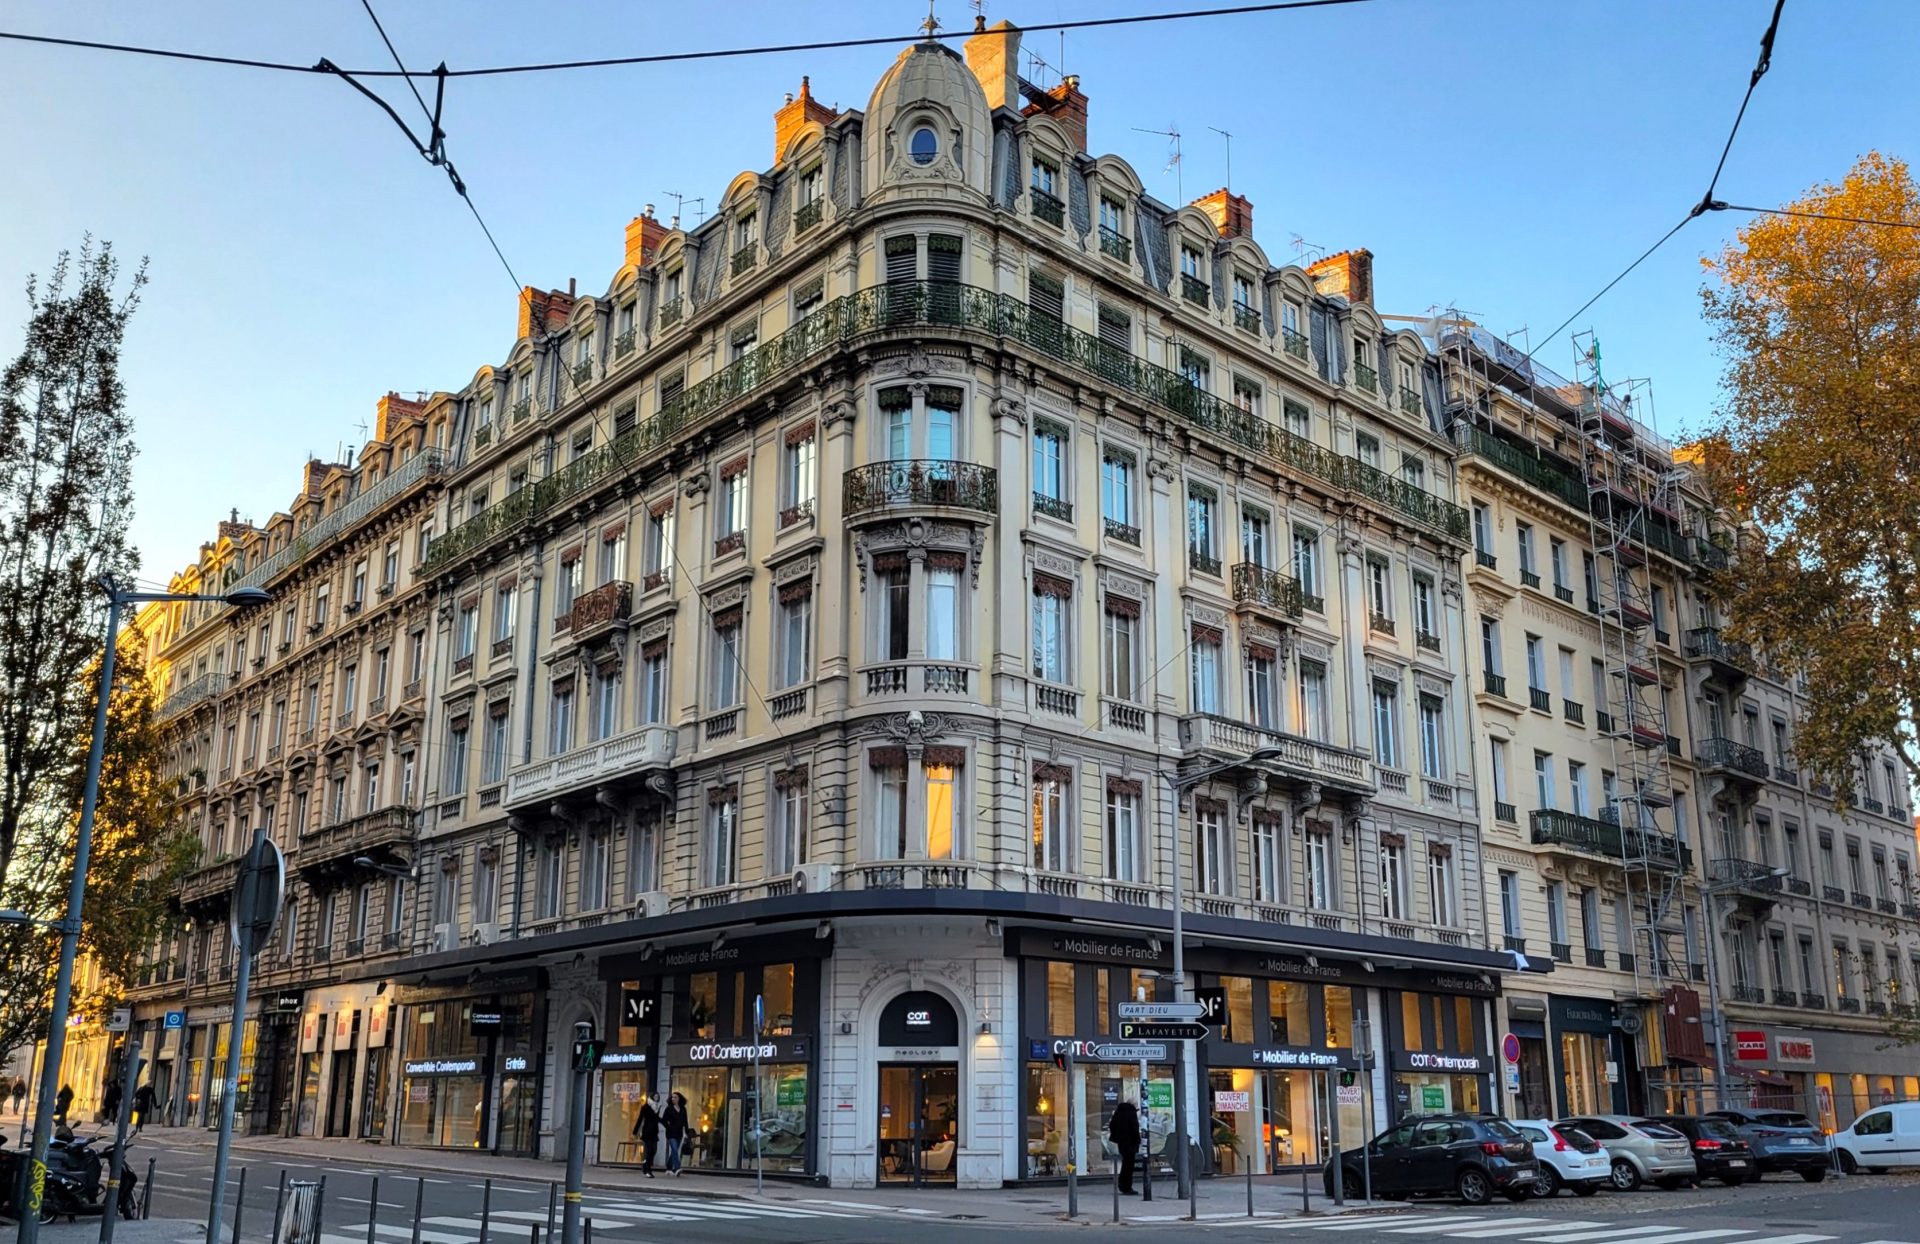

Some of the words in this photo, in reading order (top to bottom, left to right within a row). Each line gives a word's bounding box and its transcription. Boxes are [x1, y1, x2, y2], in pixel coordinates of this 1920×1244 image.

[1065, 939, 1108, 956] Mobilier
[1110, 944, 1123, 956] de
[1125, 945, 1159, 960] France
[666, 951, 697, 967] Mobilier
[699, 950, 709, 962] de
[711, 948, 739, 961] France
[1267, 960, 1301, 973] Mobilier
[1303, 963, 1313, 974] de
[1315, 964, 1341, 977] France
[1437, 976, 1463, 989] Mobilier
[1464, 979, 1473, 990] de
[1474, 980, 1495, 992] France
[280, 997, 298, 1006] phox
[1124, 1025, 1133, 1036] P
[1138, 1026, 1198, 1036] LAFAYETTE
[1262, 1050, 1298, 1064] Mobilier
[1299, 1052, 1309, 1064] de
[1310, 1053, 1338, 1064] France
[1779, 1041, 1812, 1059] KARE
[505, 1057, 526, 1071] Entrée
[602, 1054, 621, 1064] Mobilier
[622, 1054, 629, 1062] de
[629, 1053, 646, 1062] France
[406, 1061, 435, 1073] Convertible
[436, 1060, 476, 1074] Contemporain
[1219, 1092, 1245, 1101] OUVERT
[1337, 1095, 1361, 1104] DIMANCH
[1216, 1102, 1249, 1111] DIMANCHE
